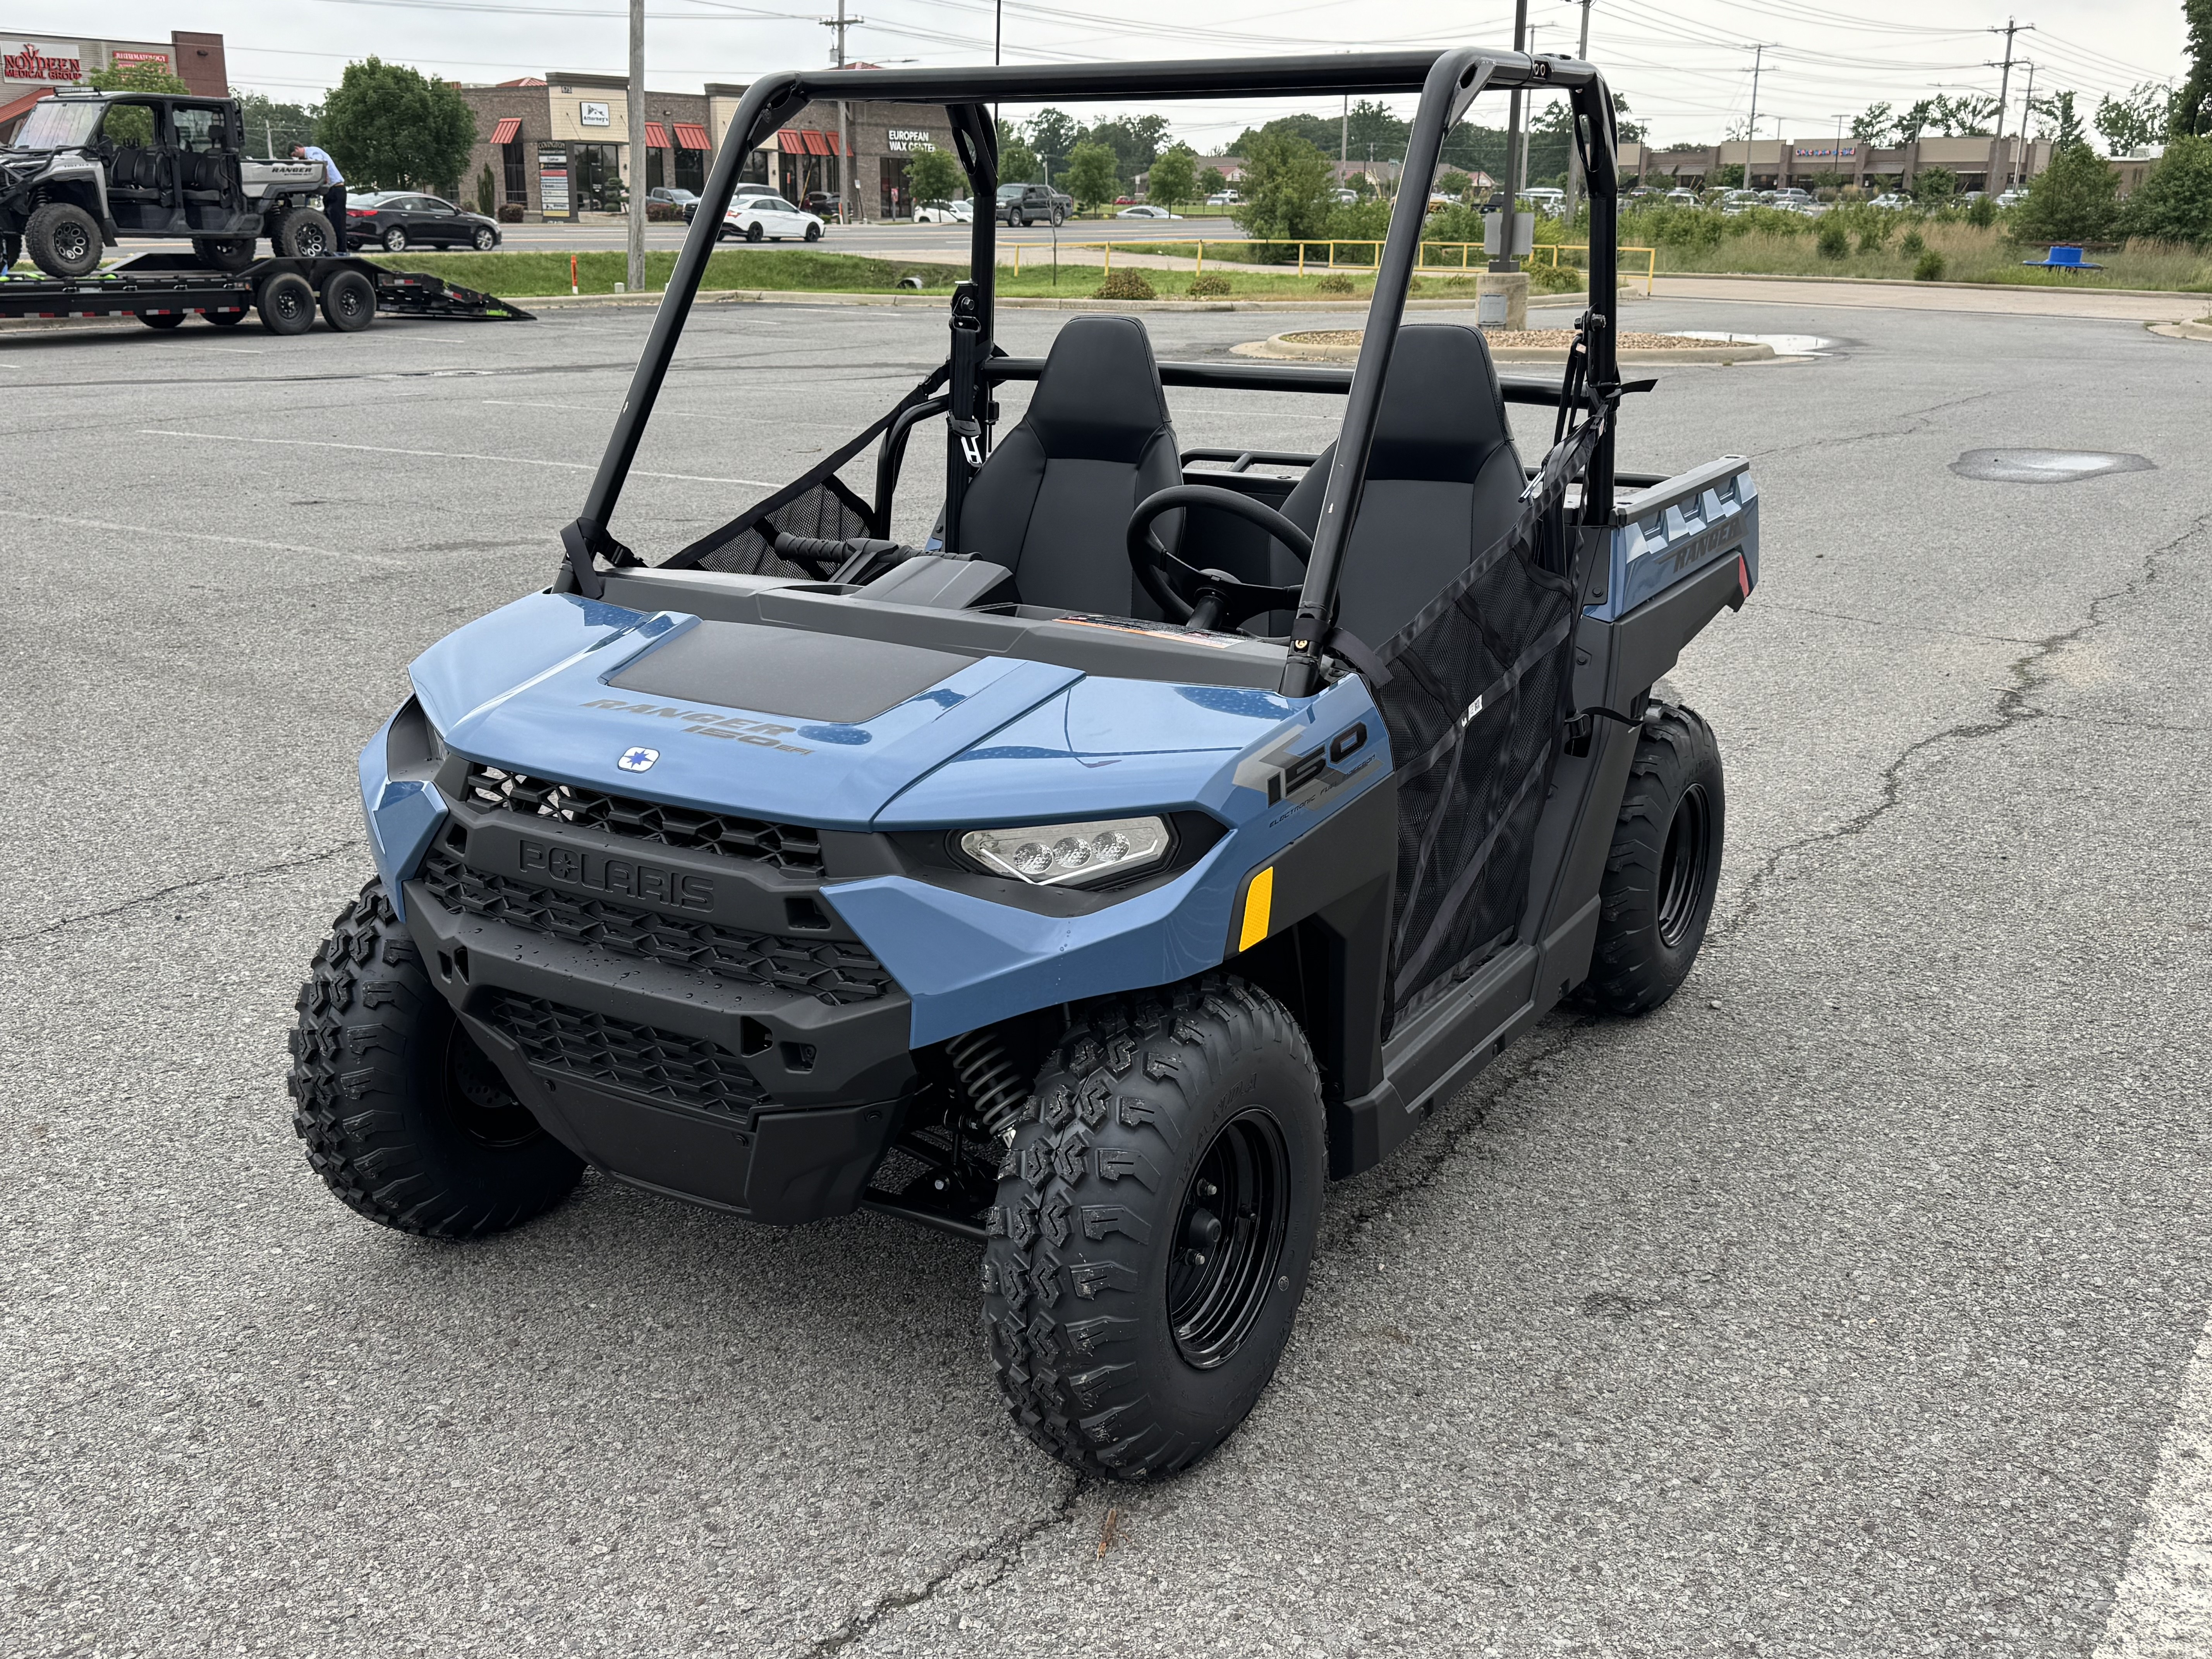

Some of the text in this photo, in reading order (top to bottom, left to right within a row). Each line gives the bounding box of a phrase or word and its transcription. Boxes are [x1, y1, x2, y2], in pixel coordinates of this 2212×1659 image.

[3, 48, 81, 72] NOYDEEN
[4, 69, 82, 81] MEDICAL GROUP
[889, 130, 929, 141] EUROPEAN
[890, 141, 907, 151] WAX
[1673, 516, 1741, 574] RANGER
[578, 699, 797, 735] RANGER
[681, 725, 782, 747] 150
[1266, 720, 1368, 809] 150
[519, 839, 714, 913] POLARIS
